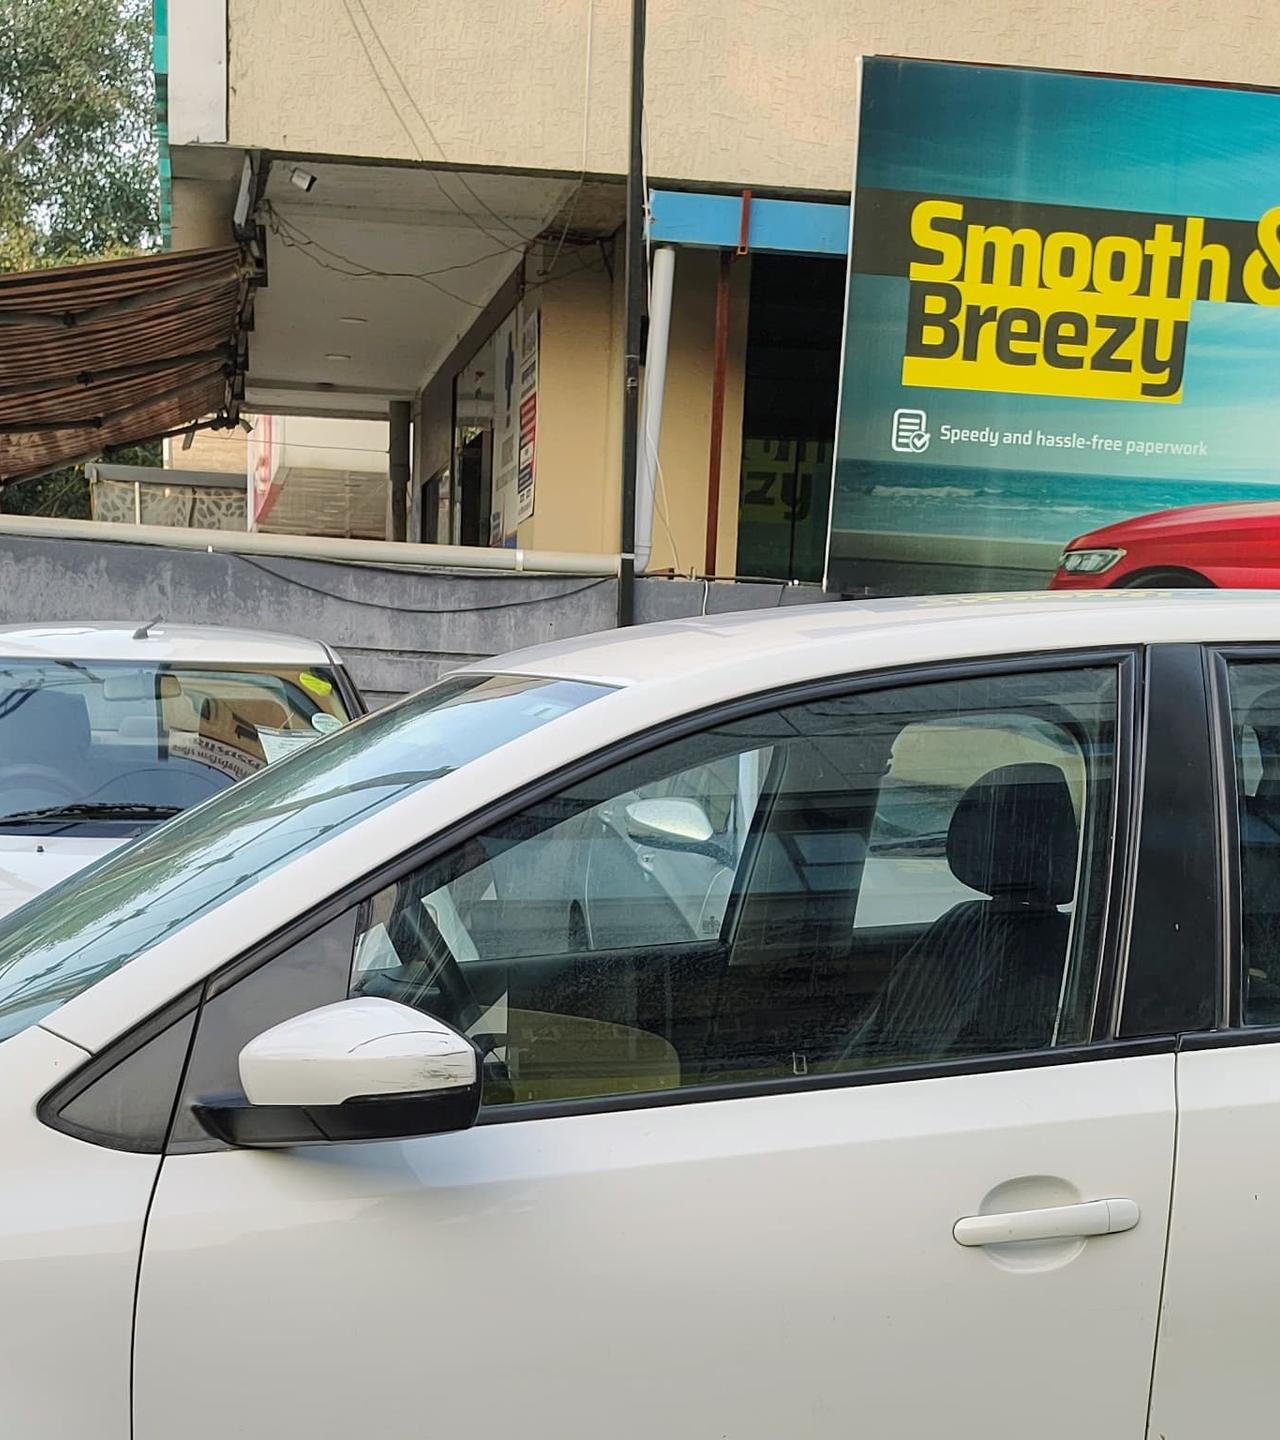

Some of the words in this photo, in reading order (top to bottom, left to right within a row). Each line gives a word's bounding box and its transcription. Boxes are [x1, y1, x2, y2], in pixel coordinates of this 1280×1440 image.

[909, 199, 1231, 303] Smooth
[905, 280, 1189, 397] Breezy
[940, 425, 999, 447] Speedy
[1003, 430, 1033, 446] and
[1036, 430, 1122, 451] hassle-free
[1125, 440, 1208, 457] paperwork
